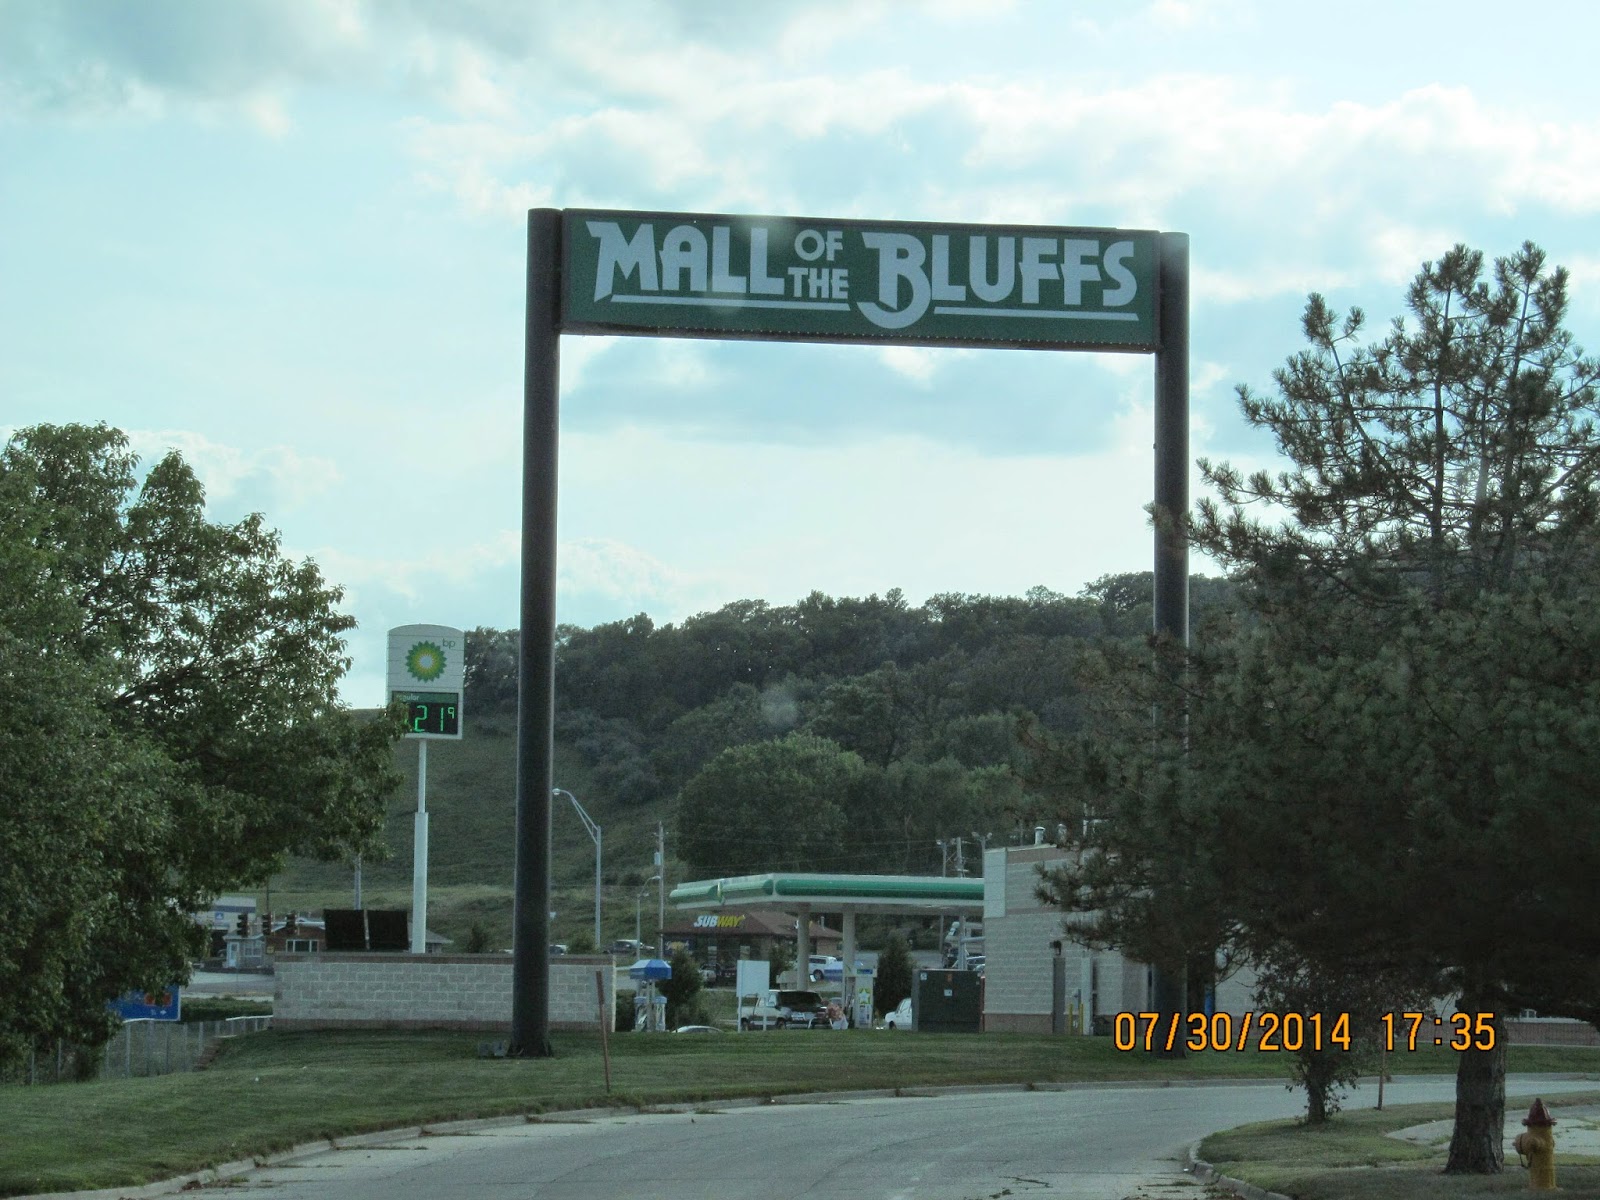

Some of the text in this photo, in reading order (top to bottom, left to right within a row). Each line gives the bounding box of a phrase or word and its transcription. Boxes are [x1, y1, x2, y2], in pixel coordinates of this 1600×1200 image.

[585, 220, 1137, 329] MALL OF THE BLUFFS
[442, 638, 455, 649] bp
[693, 914, 746, 928] SUBWAY
